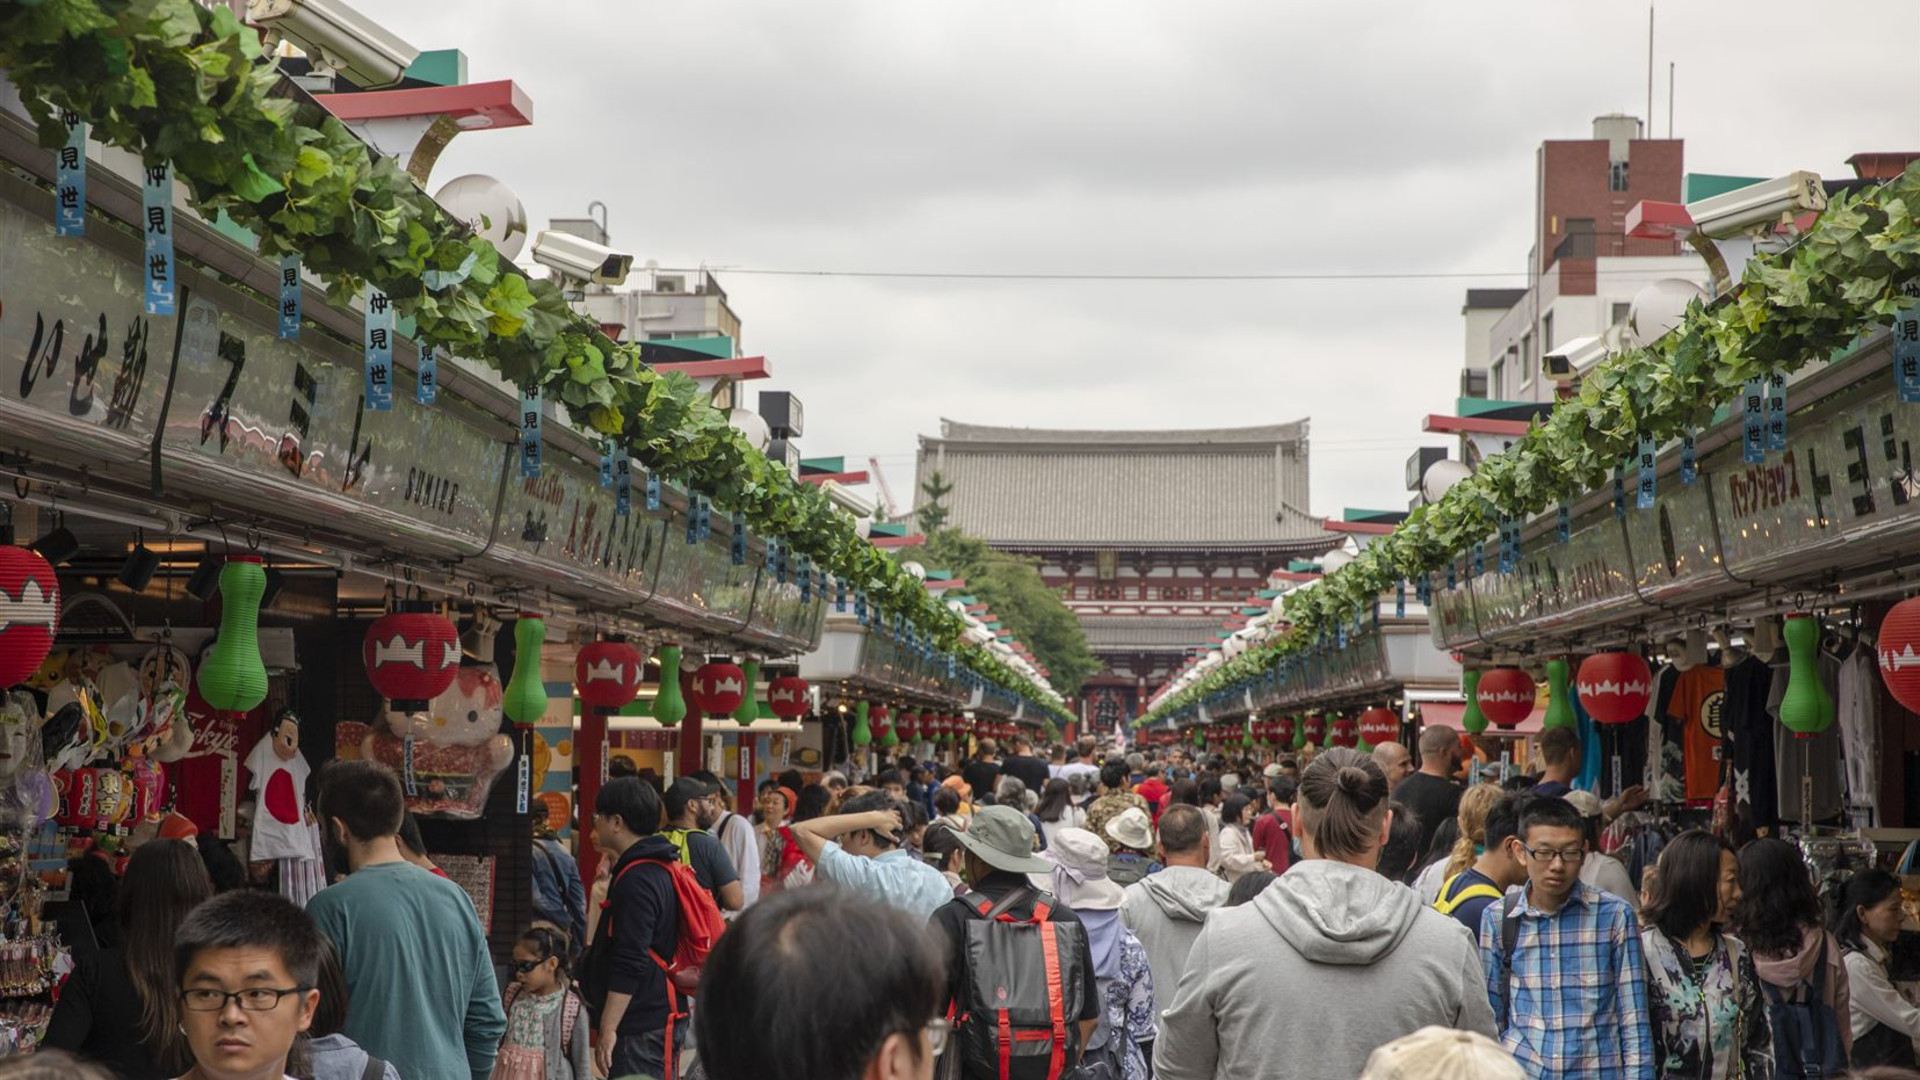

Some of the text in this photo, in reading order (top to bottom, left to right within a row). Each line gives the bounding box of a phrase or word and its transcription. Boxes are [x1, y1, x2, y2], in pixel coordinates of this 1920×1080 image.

[369, 291, 388, 386] 仲見世
[404, 465, 459, 516] SUMIRE
[98, 773, 119, 815] 東京
